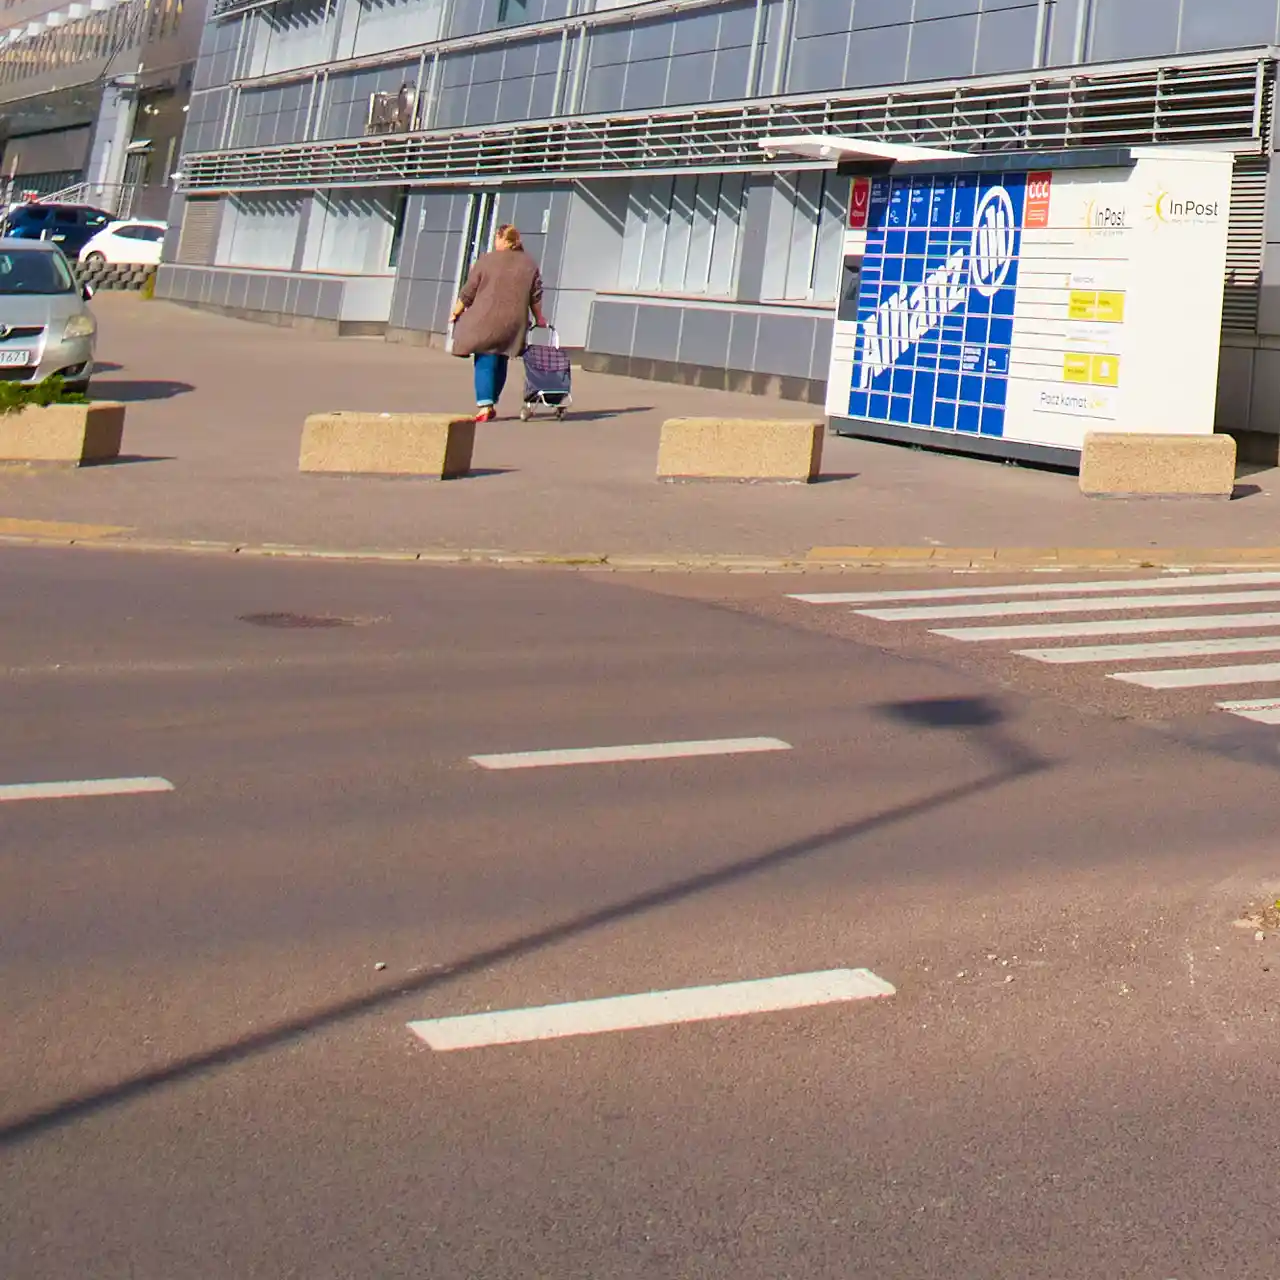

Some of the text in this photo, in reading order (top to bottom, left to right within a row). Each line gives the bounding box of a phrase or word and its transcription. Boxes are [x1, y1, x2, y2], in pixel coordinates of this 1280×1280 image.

[1094, 205, 1127, 227] InPost
[1169, 199, 1220, 217] InPost
[859, 247, 967, 390] Allianz
